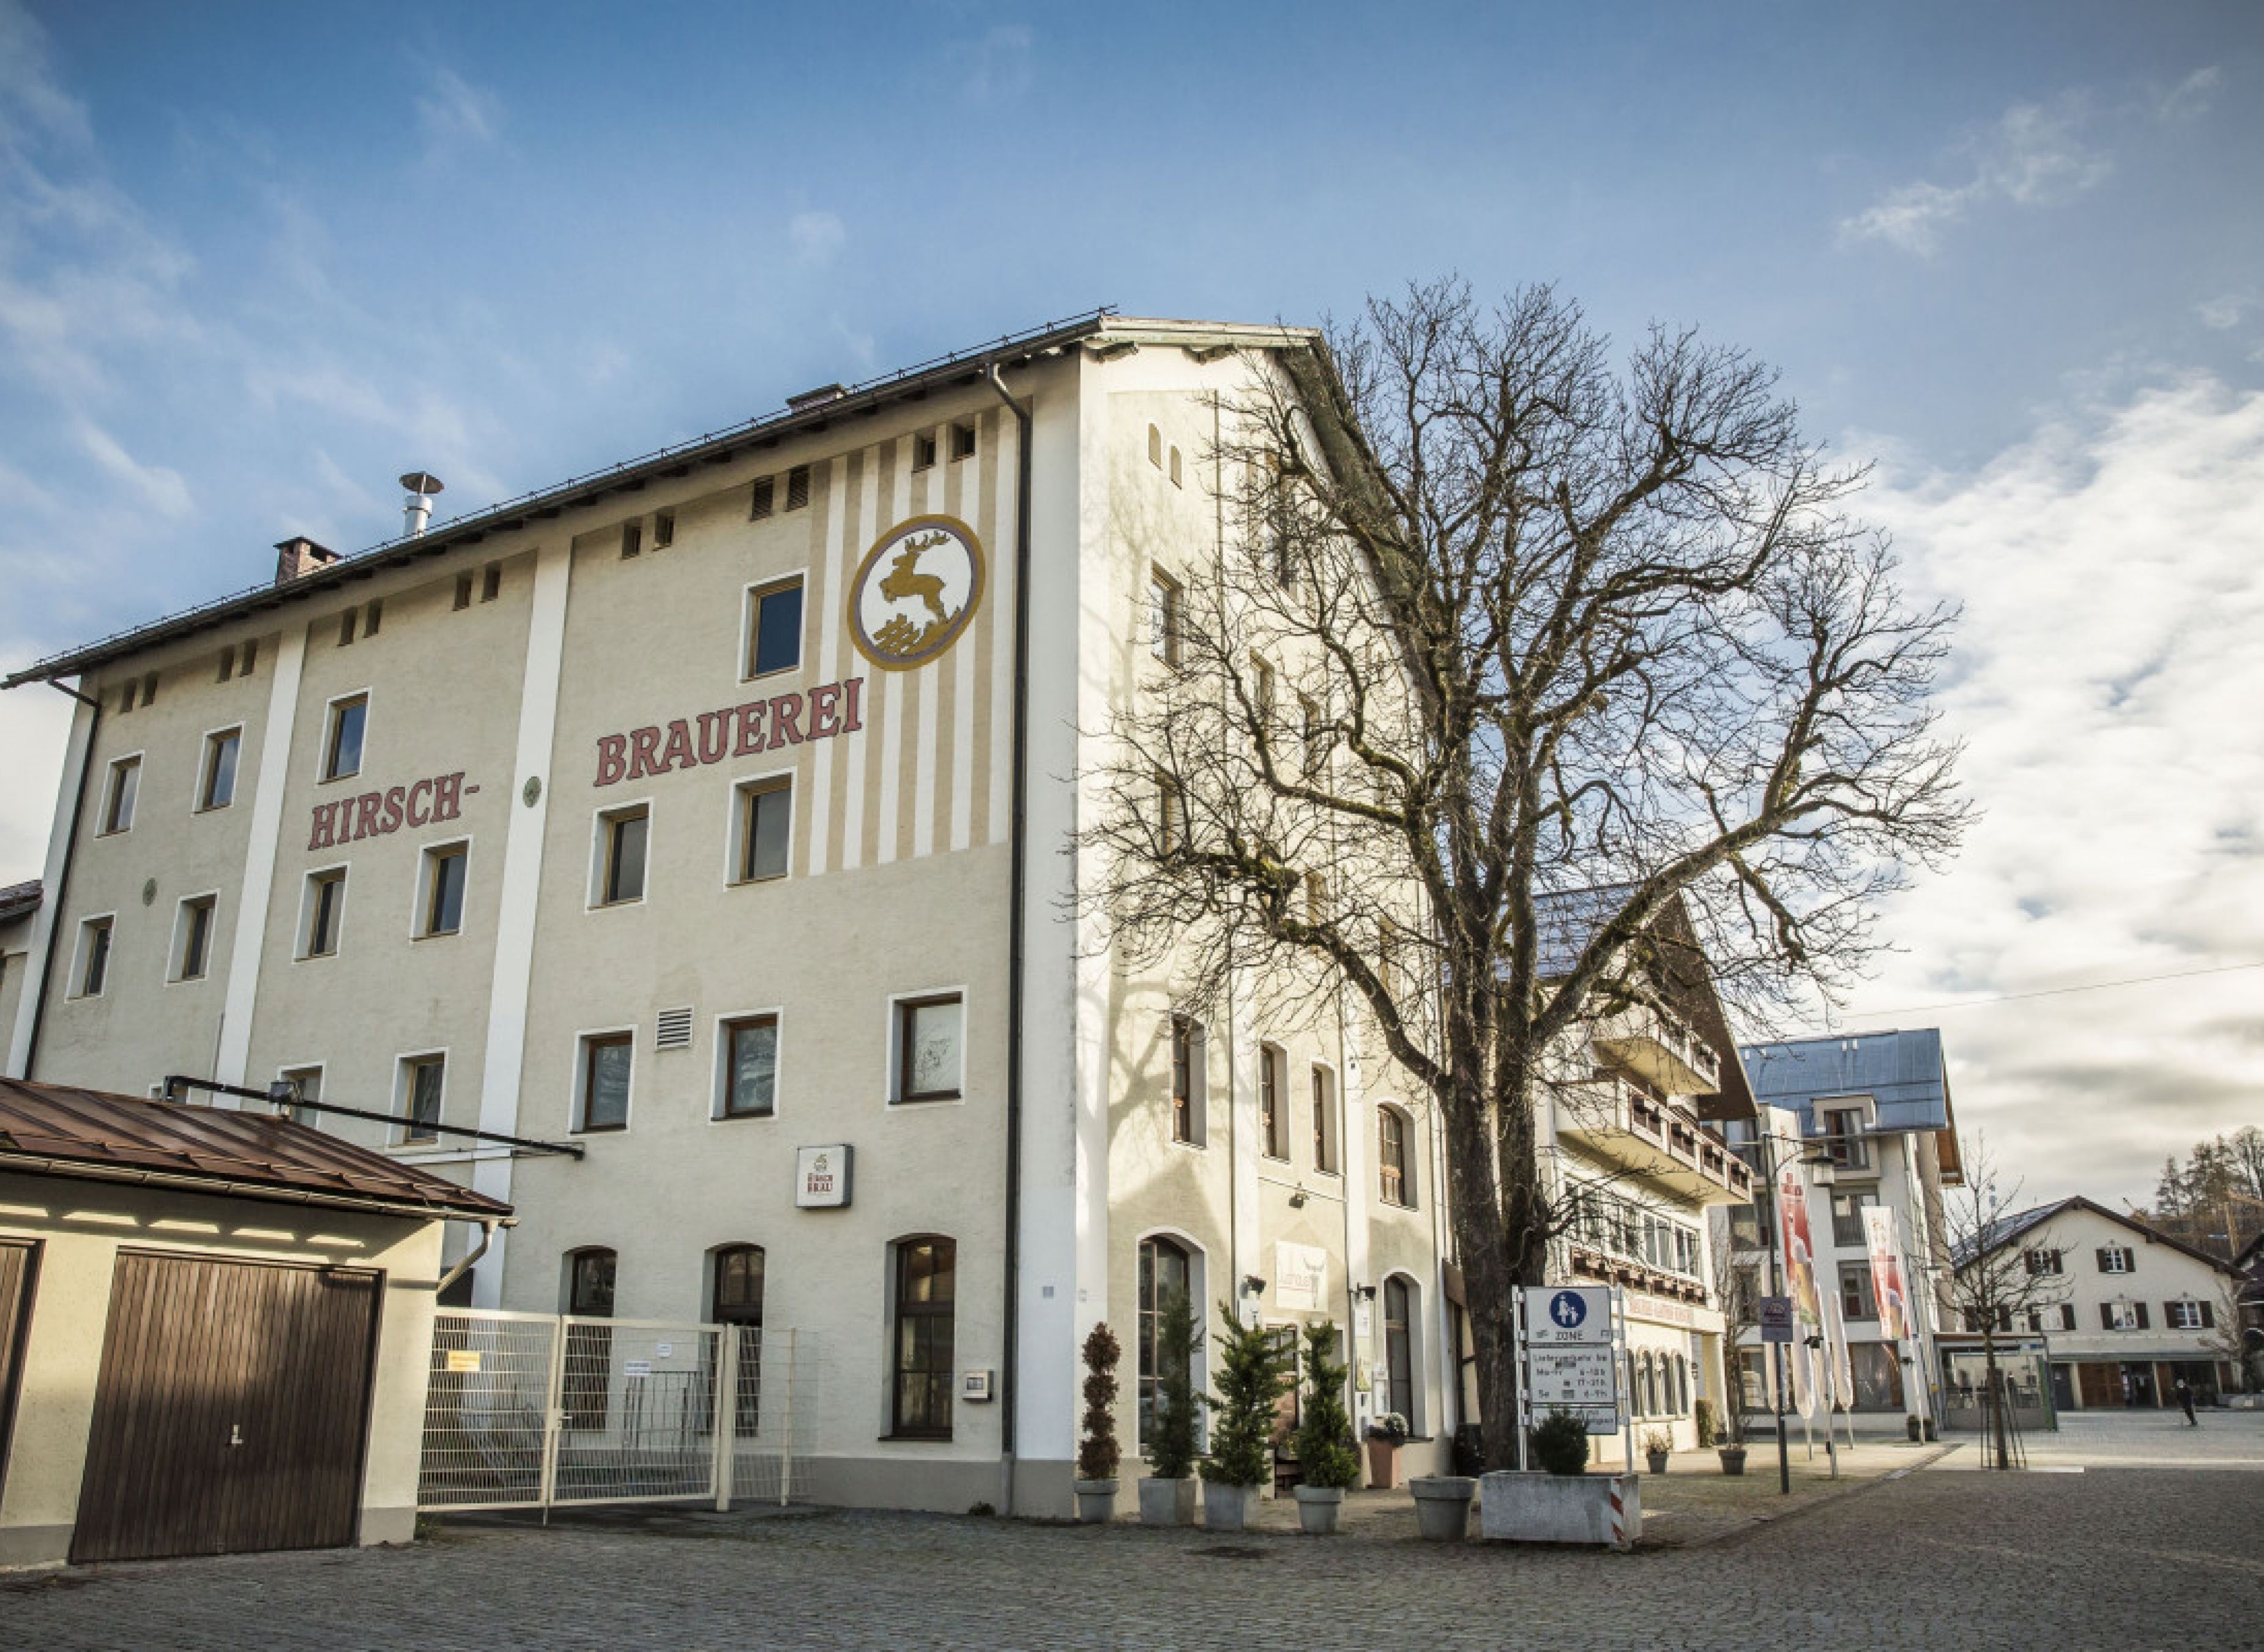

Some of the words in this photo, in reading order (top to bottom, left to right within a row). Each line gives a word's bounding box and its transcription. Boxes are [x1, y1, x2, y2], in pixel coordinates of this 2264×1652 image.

[308, 772, 480, 851] HIRSCH-
[594, 677, 864, 787] BRAUEREI
[1555, 1330, 1584, 1340] ZONE
